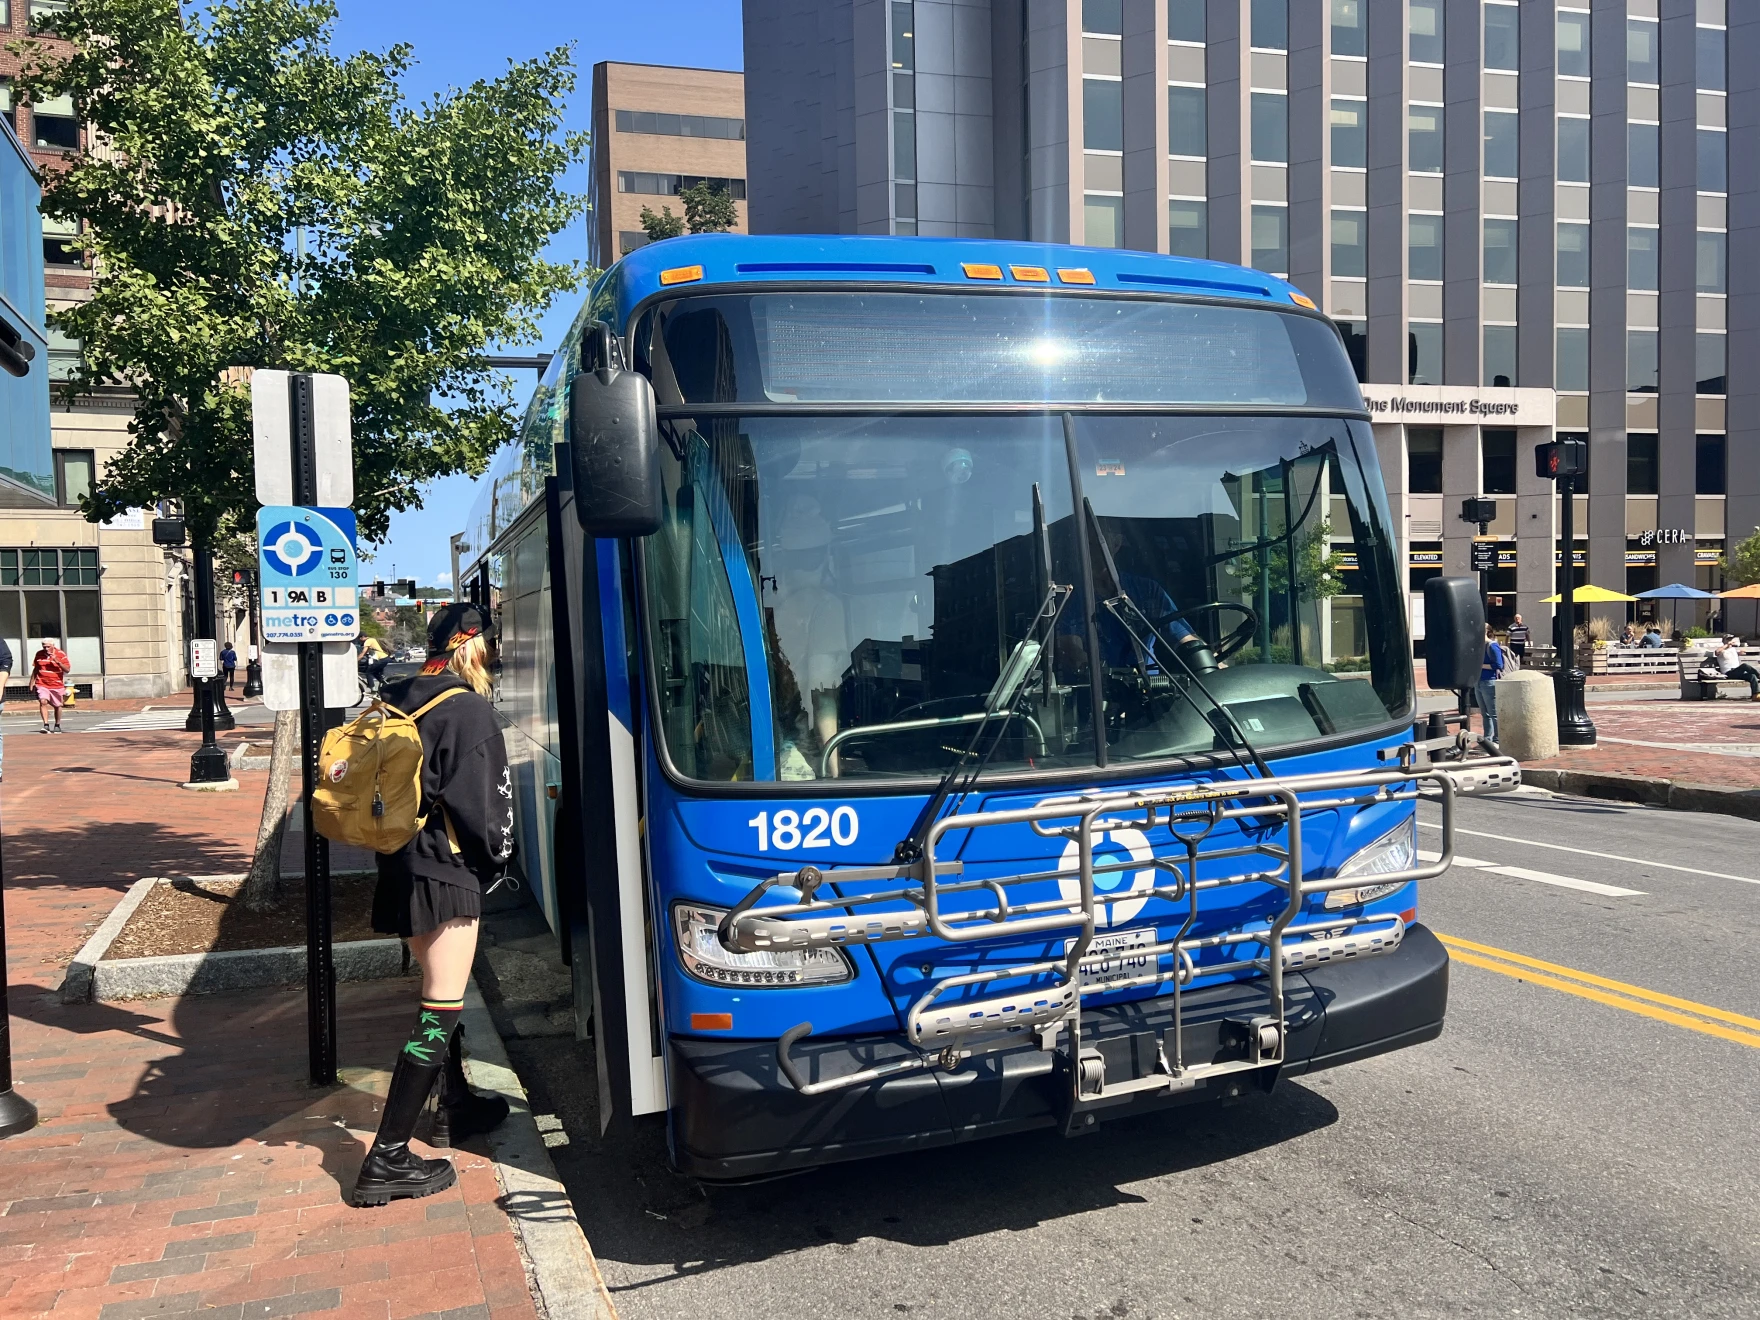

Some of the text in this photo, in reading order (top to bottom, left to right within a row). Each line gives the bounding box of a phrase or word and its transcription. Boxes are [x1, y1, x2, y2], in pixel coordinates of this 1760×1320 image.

[1364, 396, 1519, 418] One Monument Square
[1656, 528, 1686, 544] CERA
[329, 571, 348, 579] 130
[271, 591, 327, 603] 1 9A B
[265, 614, 319, 628] metro
[748, 805, 859, 851] 1820
[1095, 936, 1128, 949] MAINE
[1096, 972, 1130, 984] MUNICIPAL
